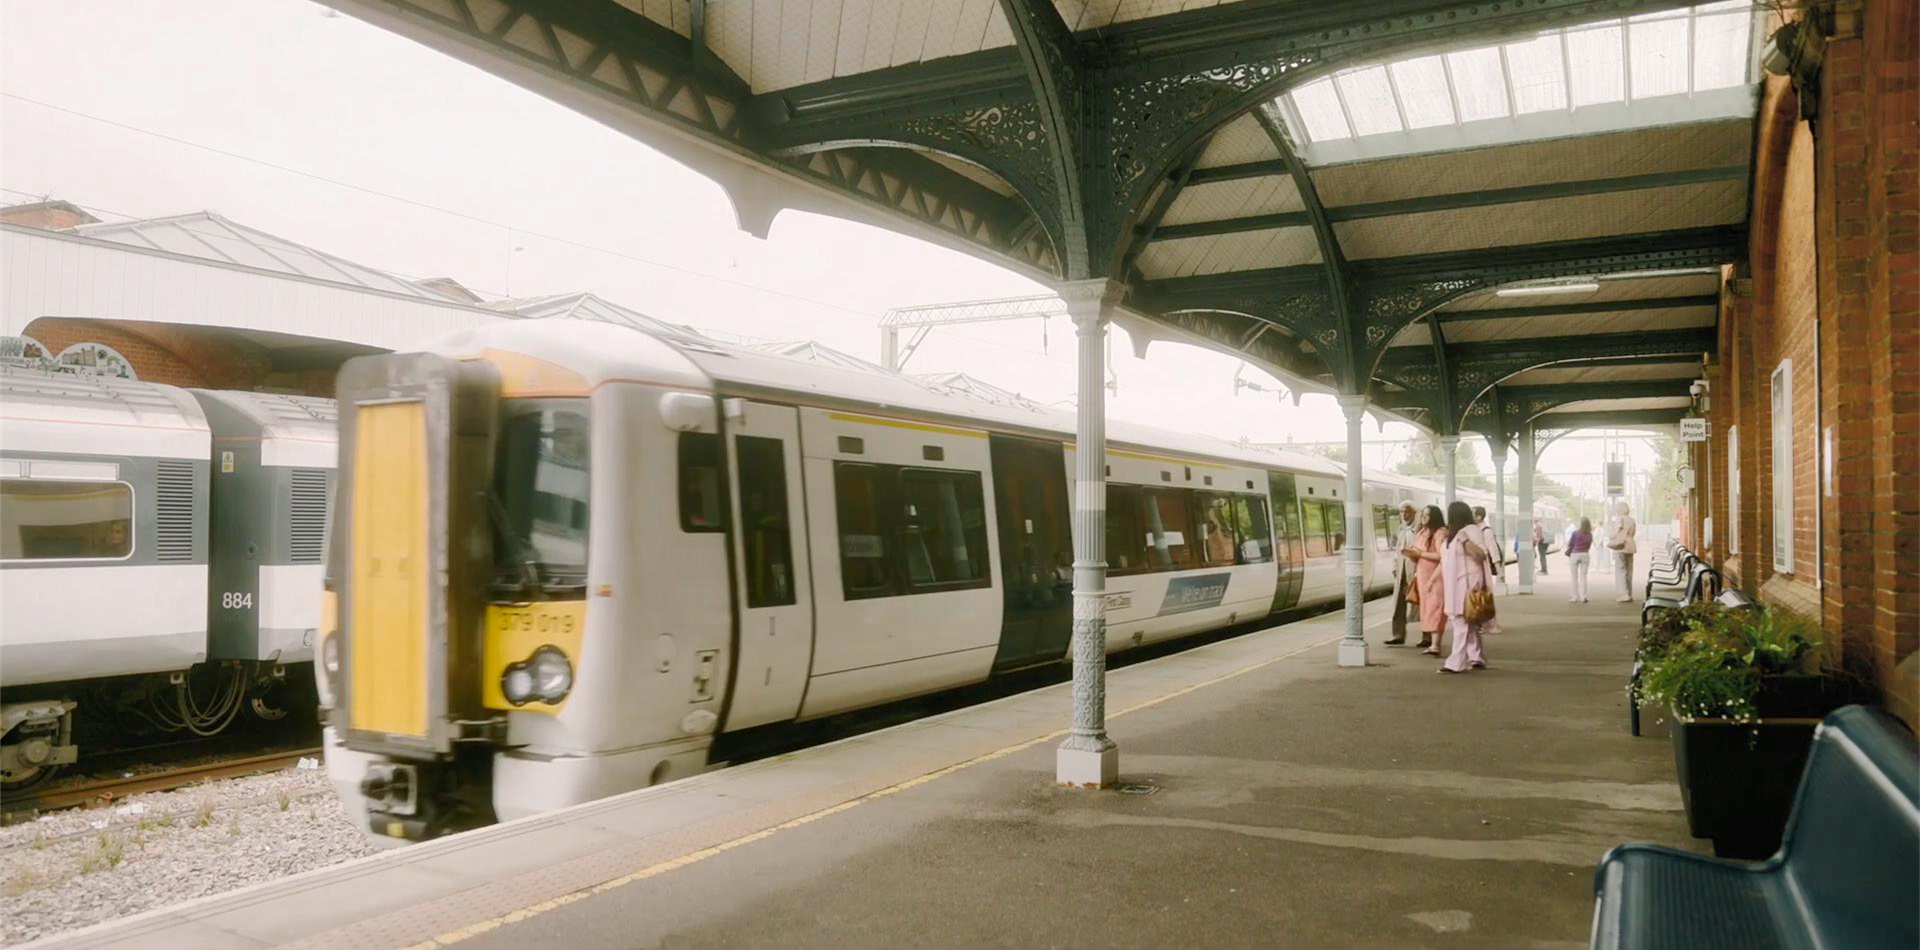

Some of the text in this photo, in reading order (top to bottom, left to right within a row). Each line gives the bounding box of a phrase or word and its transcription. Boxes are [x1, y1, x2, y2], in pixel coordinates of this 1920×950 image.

[1684, 422, 1703, 430] Help
[222, 592, 253, 609] 884
[499, 612, 575, 633] 379 019
